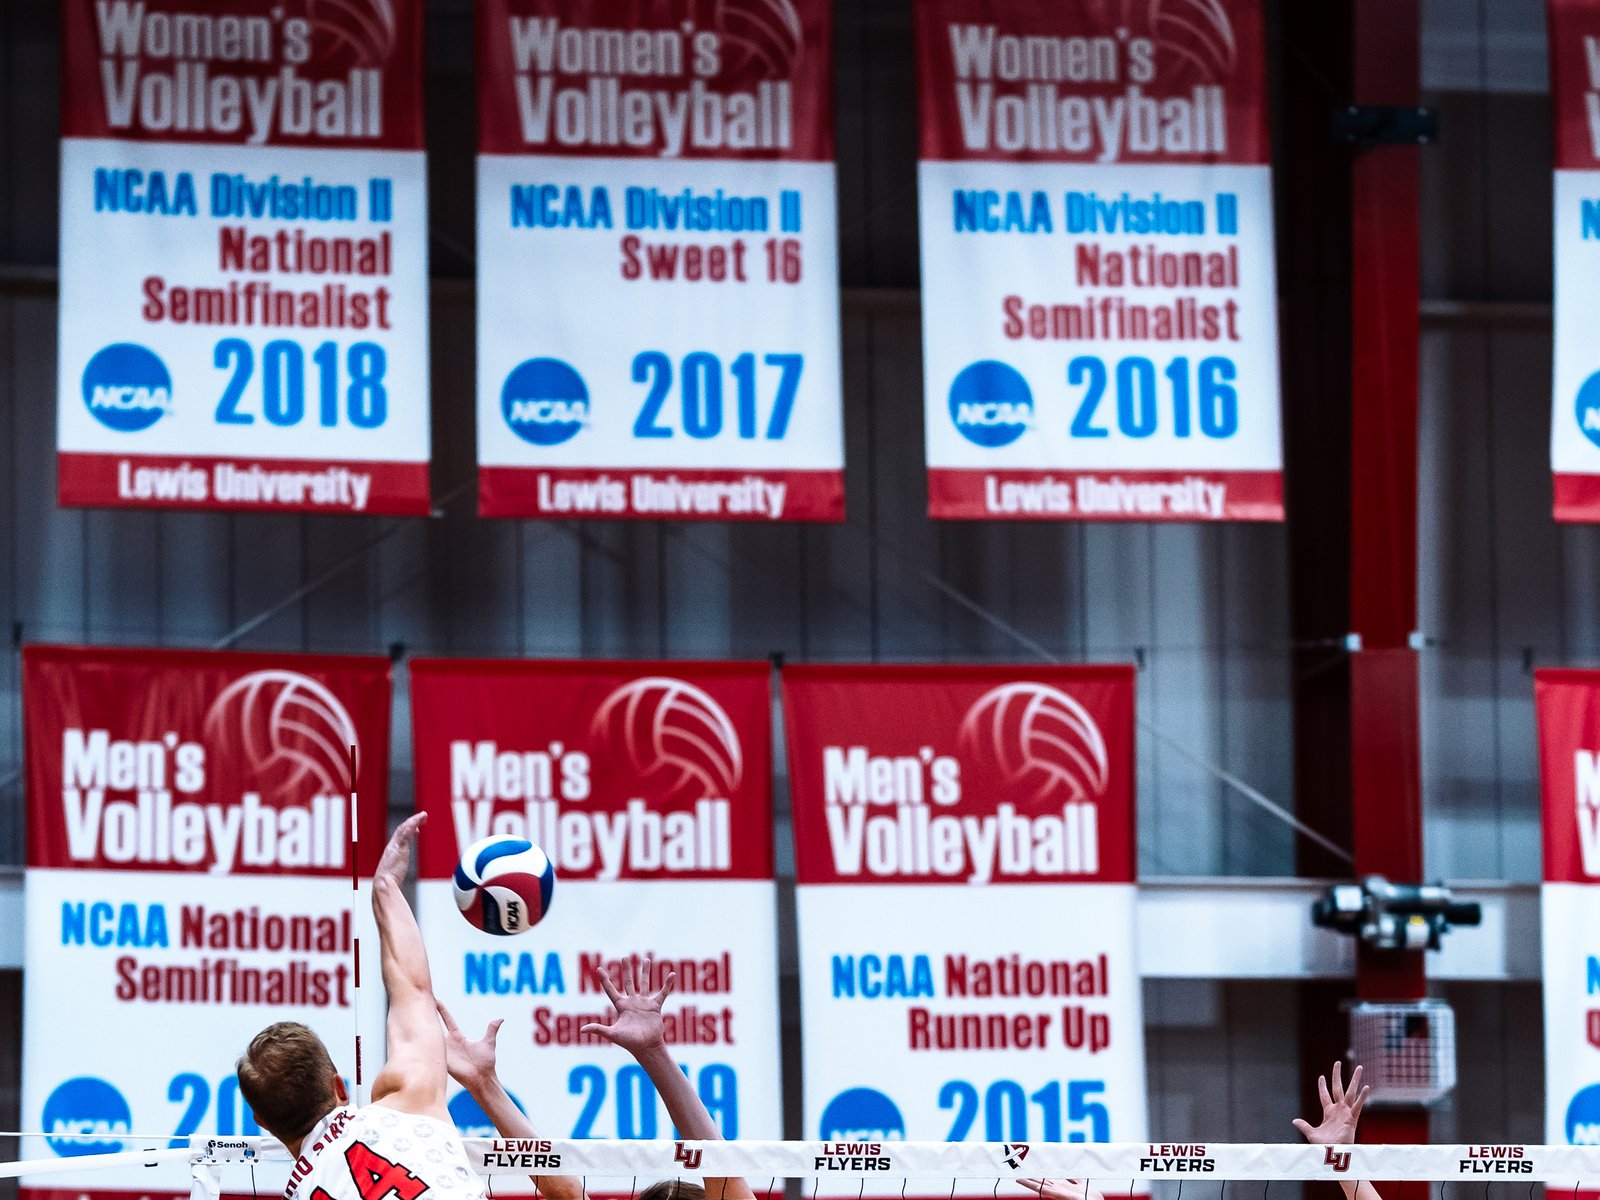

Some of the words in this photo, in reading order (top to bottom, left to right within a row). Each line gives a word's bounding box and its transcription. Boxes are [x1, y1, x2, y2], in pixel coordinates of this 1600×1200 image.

[98, 0, 310, 62] Women's
[508, 15, 720, 79] Women's
[949, 23, 1155, 83] Women's
[101, 58, 381, 145] Volleyball
[514, 78, 794, 157] Volleyball
[954, 84, 1227, 163] Volleyball
[94, 167, 198, 217] NCAA
[210, 173, 356, 222] Division
[367, 178, 392, 223] II
[510, 184, 613, 229] NCAA
[625, 188, 769, 232] Division
[780, 191, 803, 233] II
[953, 189, 1053, 235] NCAA
[1066, 193, 1204, 235] Division
[1217, 194, 1238, 236] II
[218, 226, 392, 276] National
[620, 236, 747, 283] Sweet
[765, 240, 802, 284] 16
[1075, 244, 1239, 289] National
[142, 277, 392, 330] Semifinalist
[1003, 297, 1240, 342] Semifinalist
[213, 338, 389, 429] 2018
[631, 350, 804, 440] 2017
[1067, 356, 1239, 439] 2016
[118, 460, 208, 503] Lewis
[214, 465, 372, 509] University
[537, 474, 627, 513] Lewis
[632, 476, 786, 520] University
[986, 476, 1070, 514] Lewis
[1076, 477, 1226, 520] University
[62, 729, 205, 791] Men's
[450, 741, 590, 801] Men's
[823, 746, 959, 803] Men's
[64, 790, 346, 874] Volleyball
[825, 801, 1099, 885] Volleyball
[61, 902, 170, 948] NCAA
[180, 906, 352, 954] National
[506, 900, 520, 931] NCAA
[115, 957, 350, 1007] Semifinalist
[464, 951, 565, 995] NCAA
[831, 954, 935, 999] NCAA
[944, 953, 1109, 998] National
[909, 1007, 1052, 1050] Runner
[1062, 1007, 1110, 1053] Up
[568, 1063, 739, 1140] 209
[937, 1079, 1110, 1142] 2015
[217, 1140, 249, 1149] Senoh
[484, 1154, 561, 1168] FLYERS
[493, 1140, 552, 1152] LEWIS
[814, 1157, 891, 1170] FLYERS
[824, 1143, 881, 1155] LEWIS
[1139, 1158, 1215, 1172] FLYERS
[1149, 1145, 1206, 1157] LEWIS
[1459, 1160, 1533, 1174] FLYERS
[1468, 1146, 1524, 1158] LEWIS
